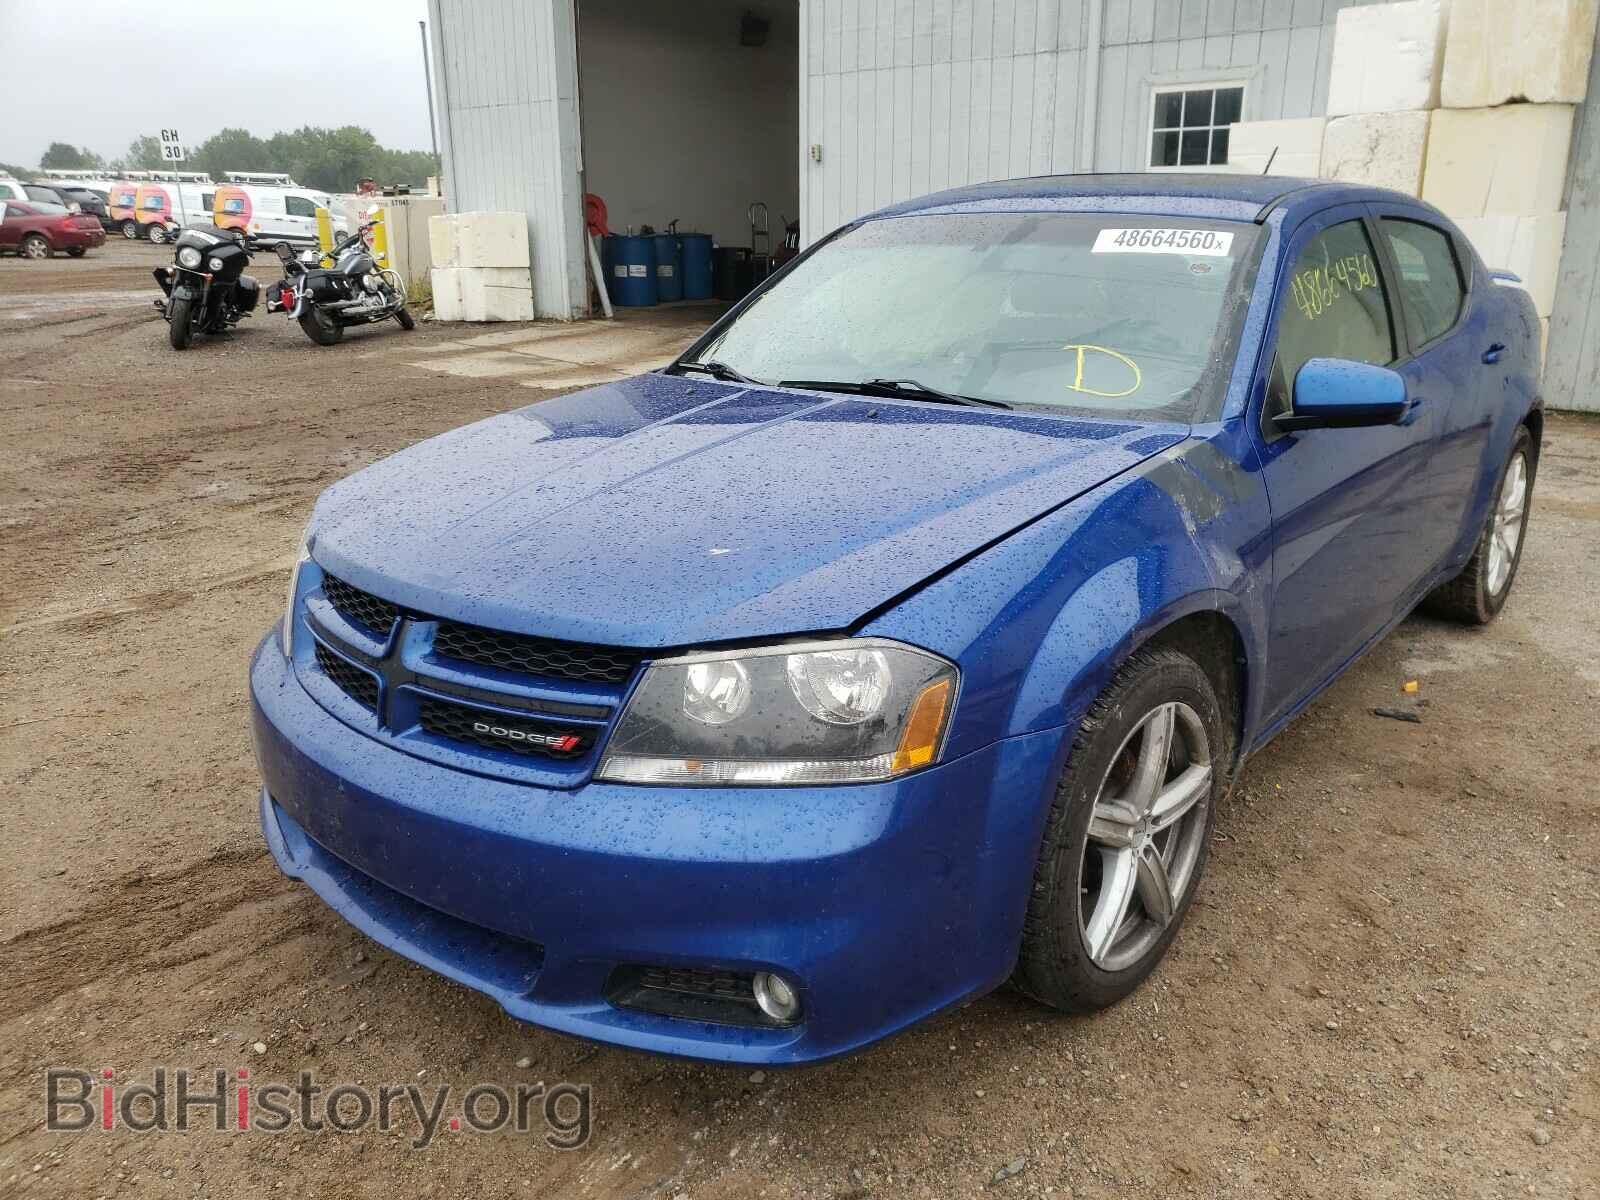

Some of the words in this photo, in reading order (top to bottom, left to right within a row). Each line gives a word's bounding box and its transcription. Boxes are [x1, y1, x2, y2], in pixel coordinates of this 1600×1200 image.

[161, 129, 179, 142] GH
[165, 145, 181, 158] 30
[1063, 344, 1141, 397] D
[473, 722, 565, 747] DODGE
